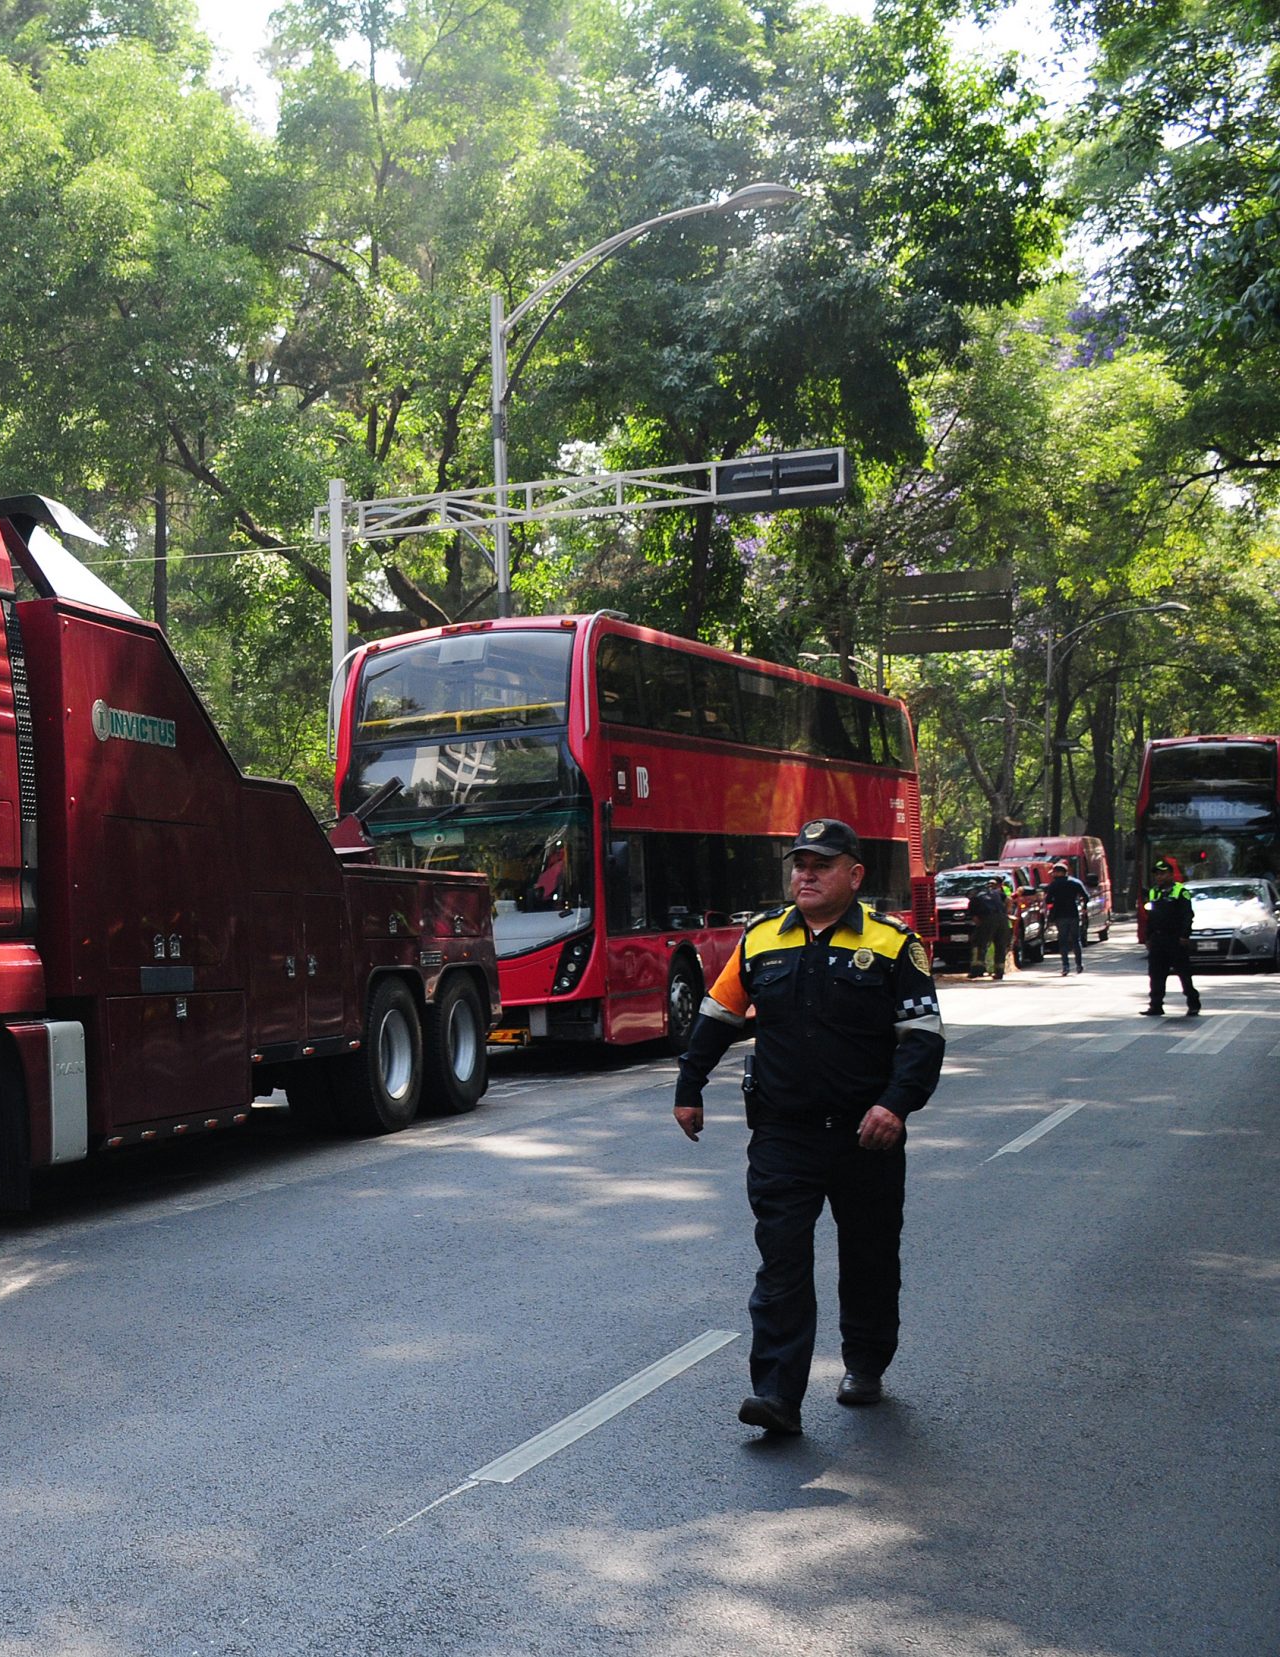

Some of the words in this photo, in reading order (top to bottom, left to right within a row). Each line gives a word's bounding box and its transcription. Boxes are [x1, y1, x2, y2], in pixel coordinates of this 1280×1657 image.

[109, 708, 176, 747] INVICTUS
[1199, 801, 1244, 818] MARTE
[55, 1060, 85, 1076] MAN
